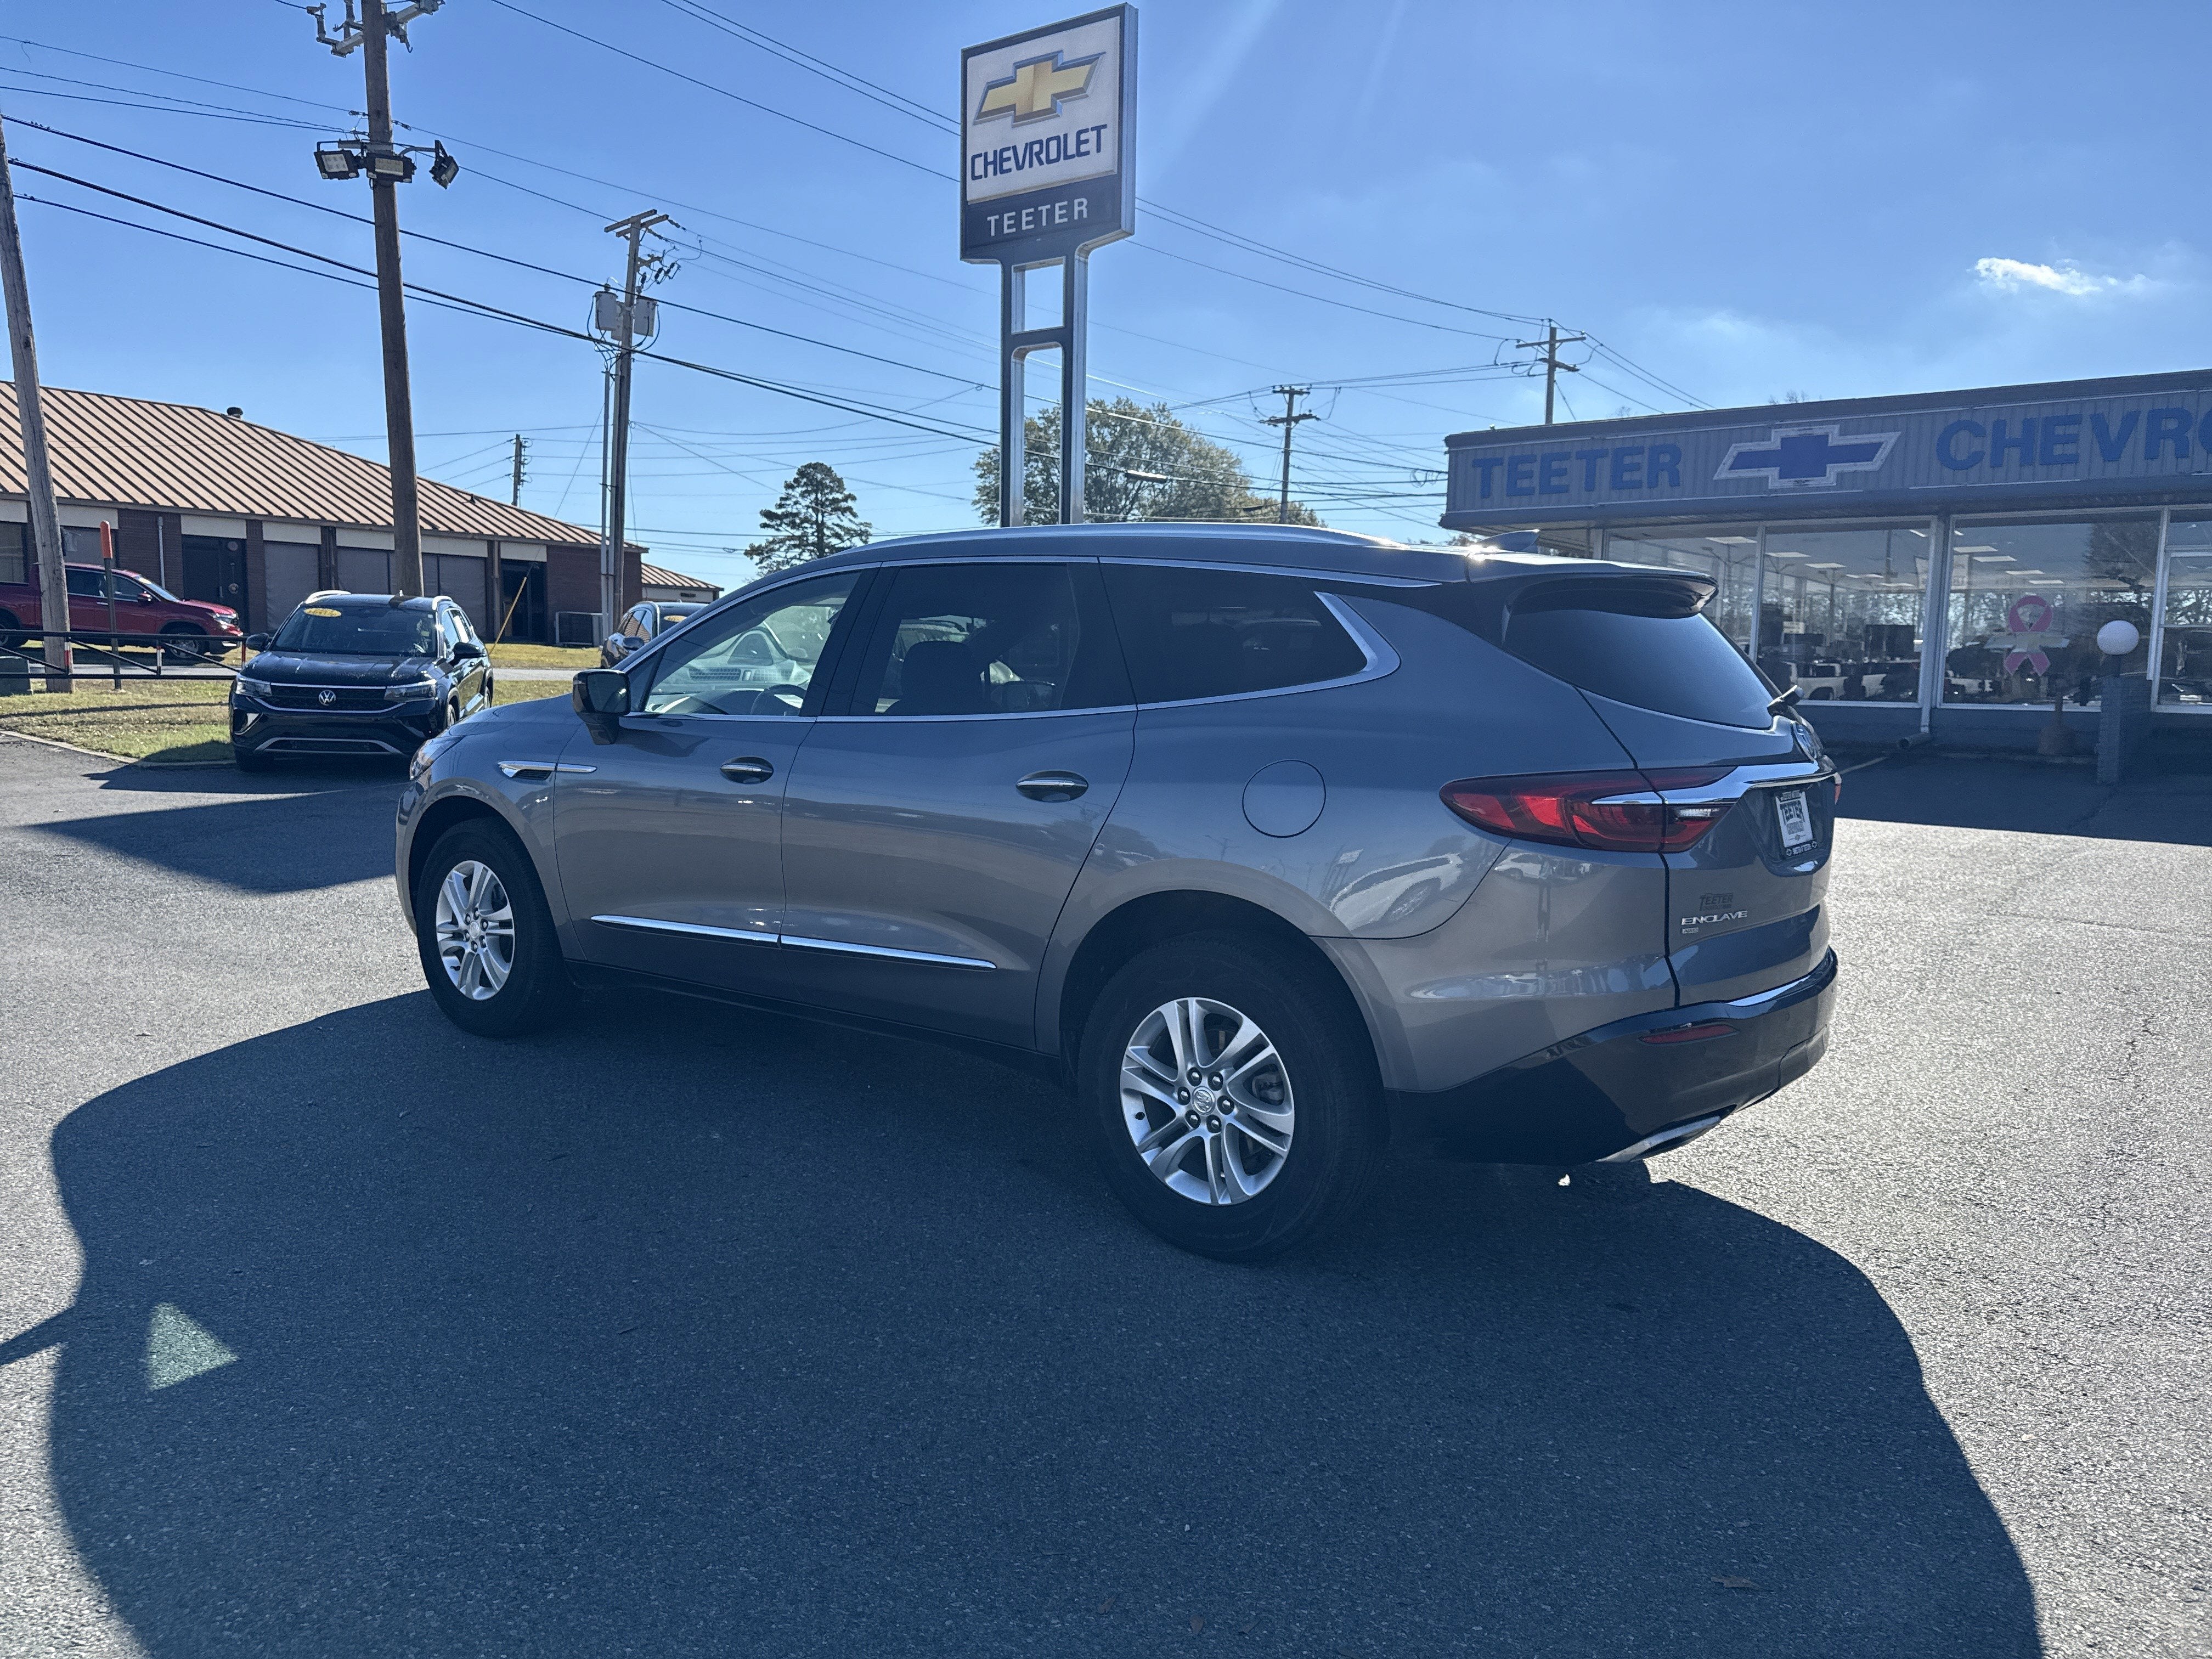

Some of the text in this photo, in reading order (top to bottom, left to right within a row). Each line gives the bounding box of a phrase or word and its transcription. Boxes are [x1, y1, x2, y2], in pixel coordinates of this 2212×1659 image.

[971, 124, 1107, 180] CHEVROLET
[987, 198, 1088, 236] TEETER
[1472, 443, 1681, 499] TEETER
[1681, 911, 1747, 925] ENCLAVE
[1700, 894, 1733, 911] TEETER
